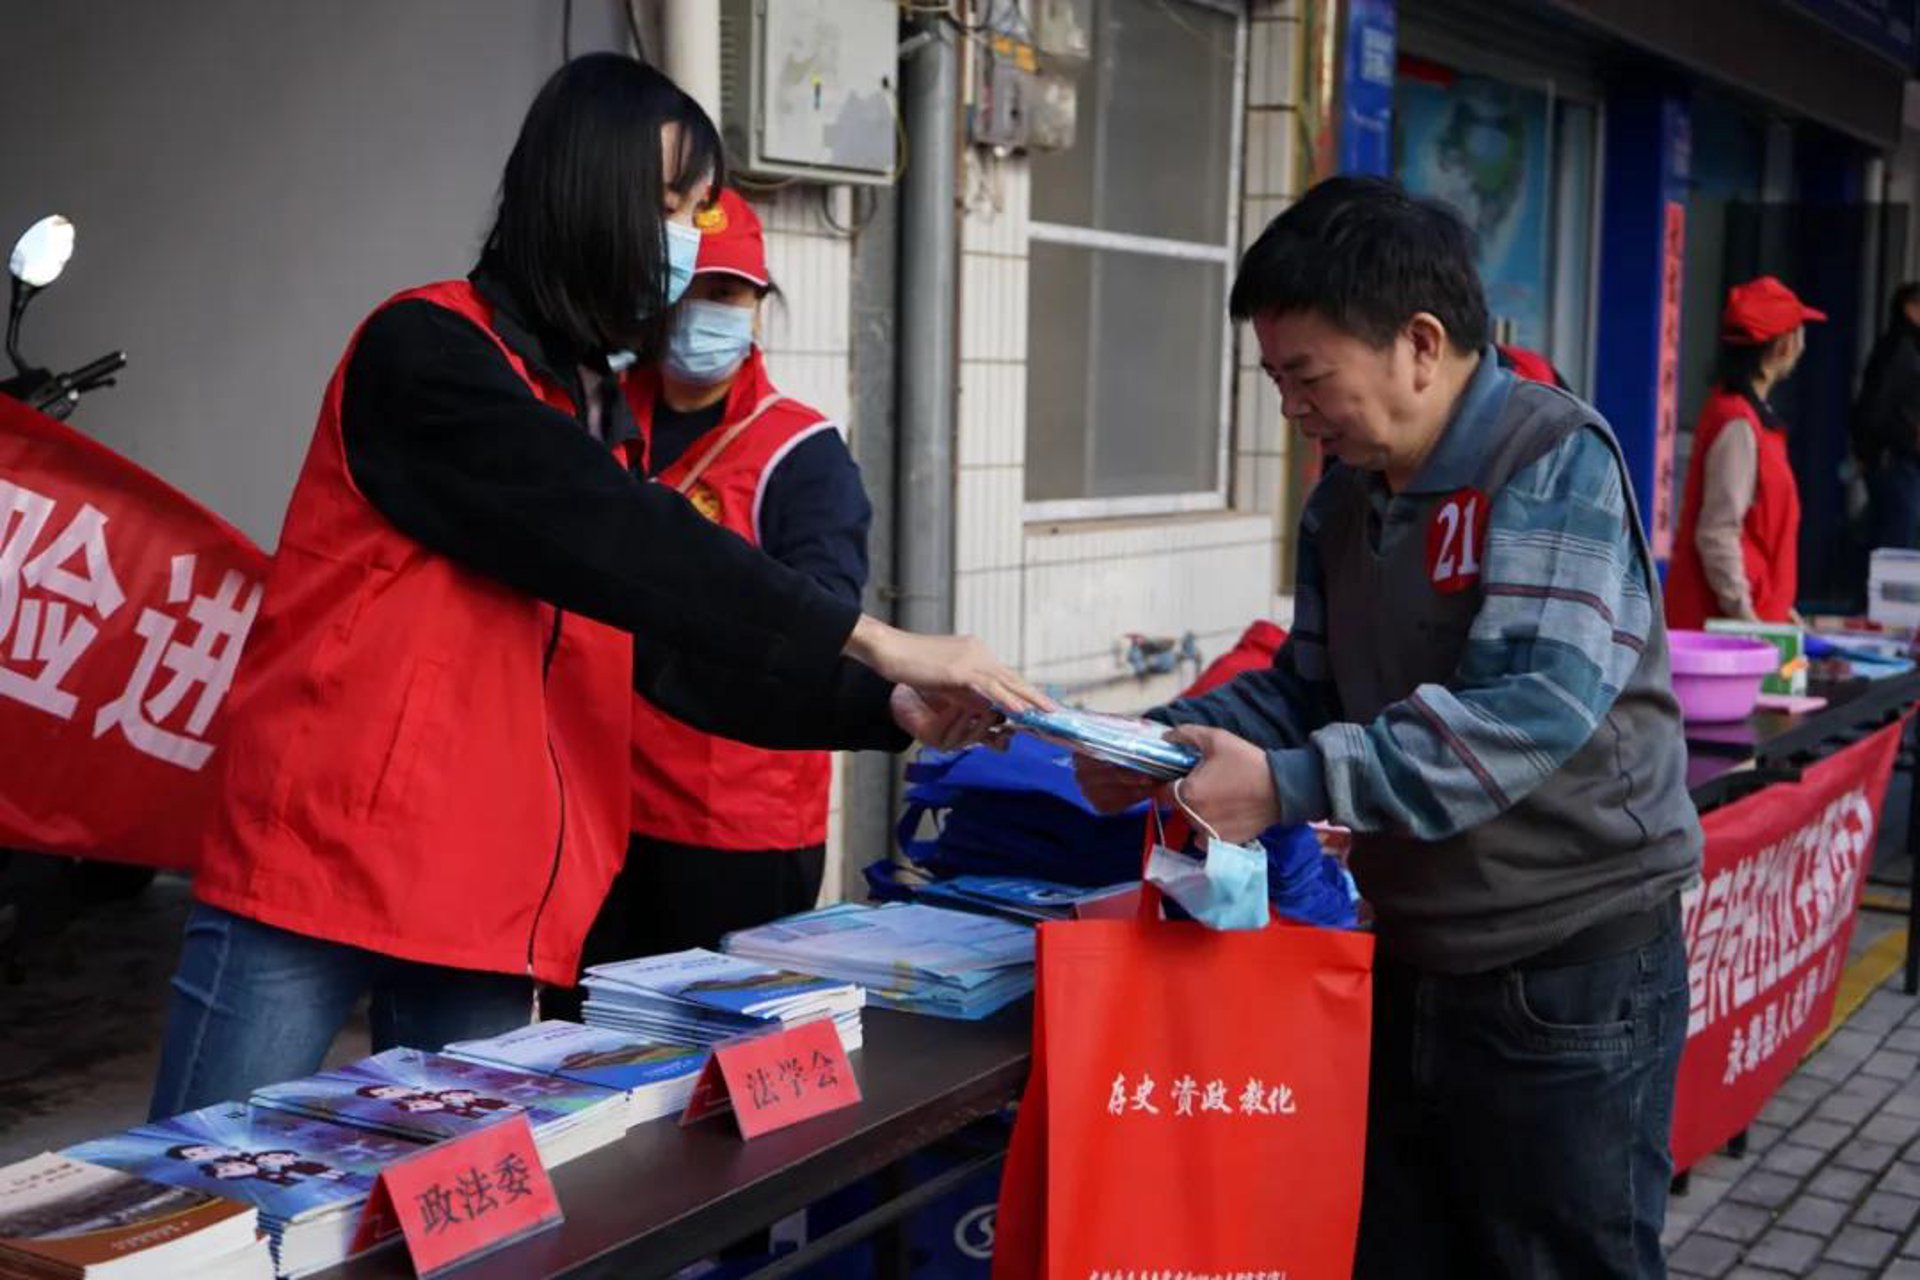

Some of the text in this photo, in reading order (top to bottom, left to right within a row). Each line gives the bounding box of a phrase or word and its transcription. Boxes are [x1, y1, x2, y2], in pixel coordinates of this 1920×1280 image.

[1433, 497, 1479, 581] 21
[744, 1048, 838, 1112] 法学会
[1107, 1071, 1160, 1116] 存史
[1238, 1076, 1297, 1116] 教化
[414, 1152, 533, 1236] 政法委
